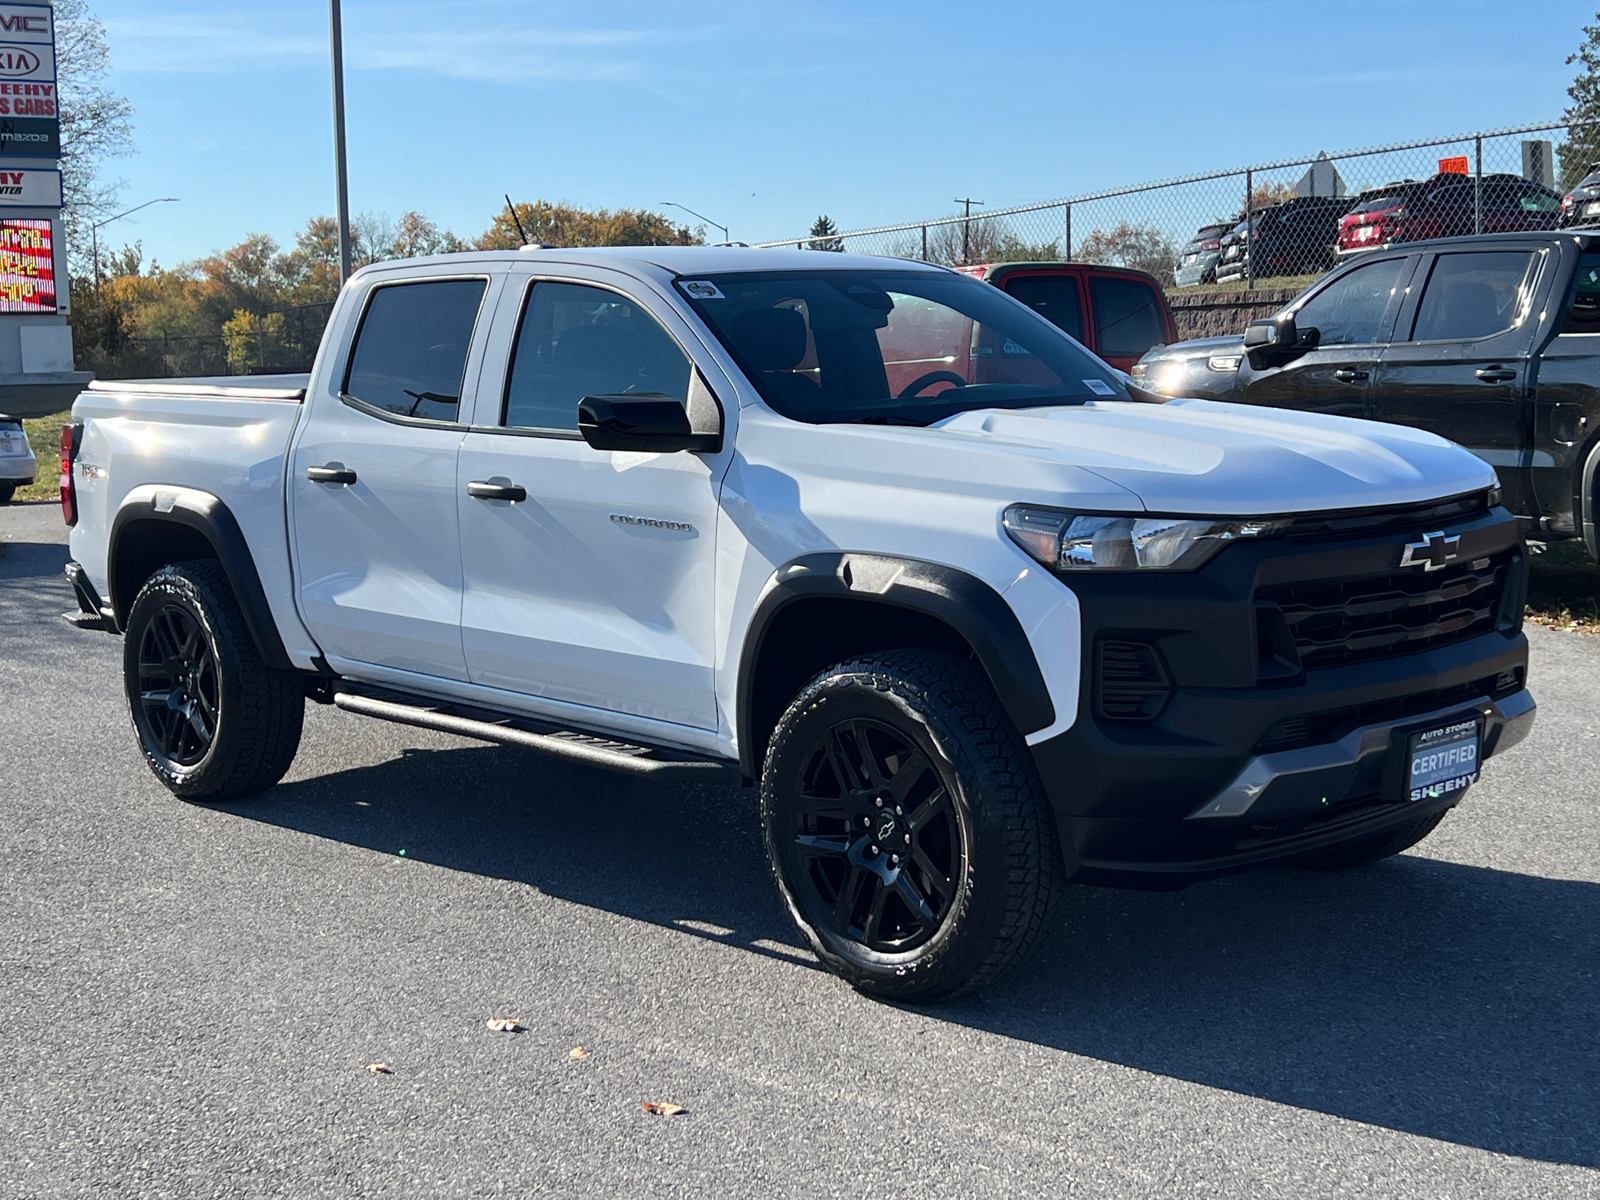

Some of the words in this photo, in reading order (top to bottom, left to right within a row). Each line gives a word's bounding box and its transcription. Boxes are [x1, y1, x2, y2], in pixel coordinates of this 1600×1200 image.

[1, 83, 54, 97] EEHY
[13, 97, 56, 117] CARS
[1, 133, 49, 142] mazda
[609, 512, 692, 532] COLORADO
[1420, 728, 1444, 741] AUTO
[1444, 720, 1477, 735] STORES
[1411, 744, 1477, 776] CERTIFIED
[1410, 772, 1477, 802] SHEEHY
